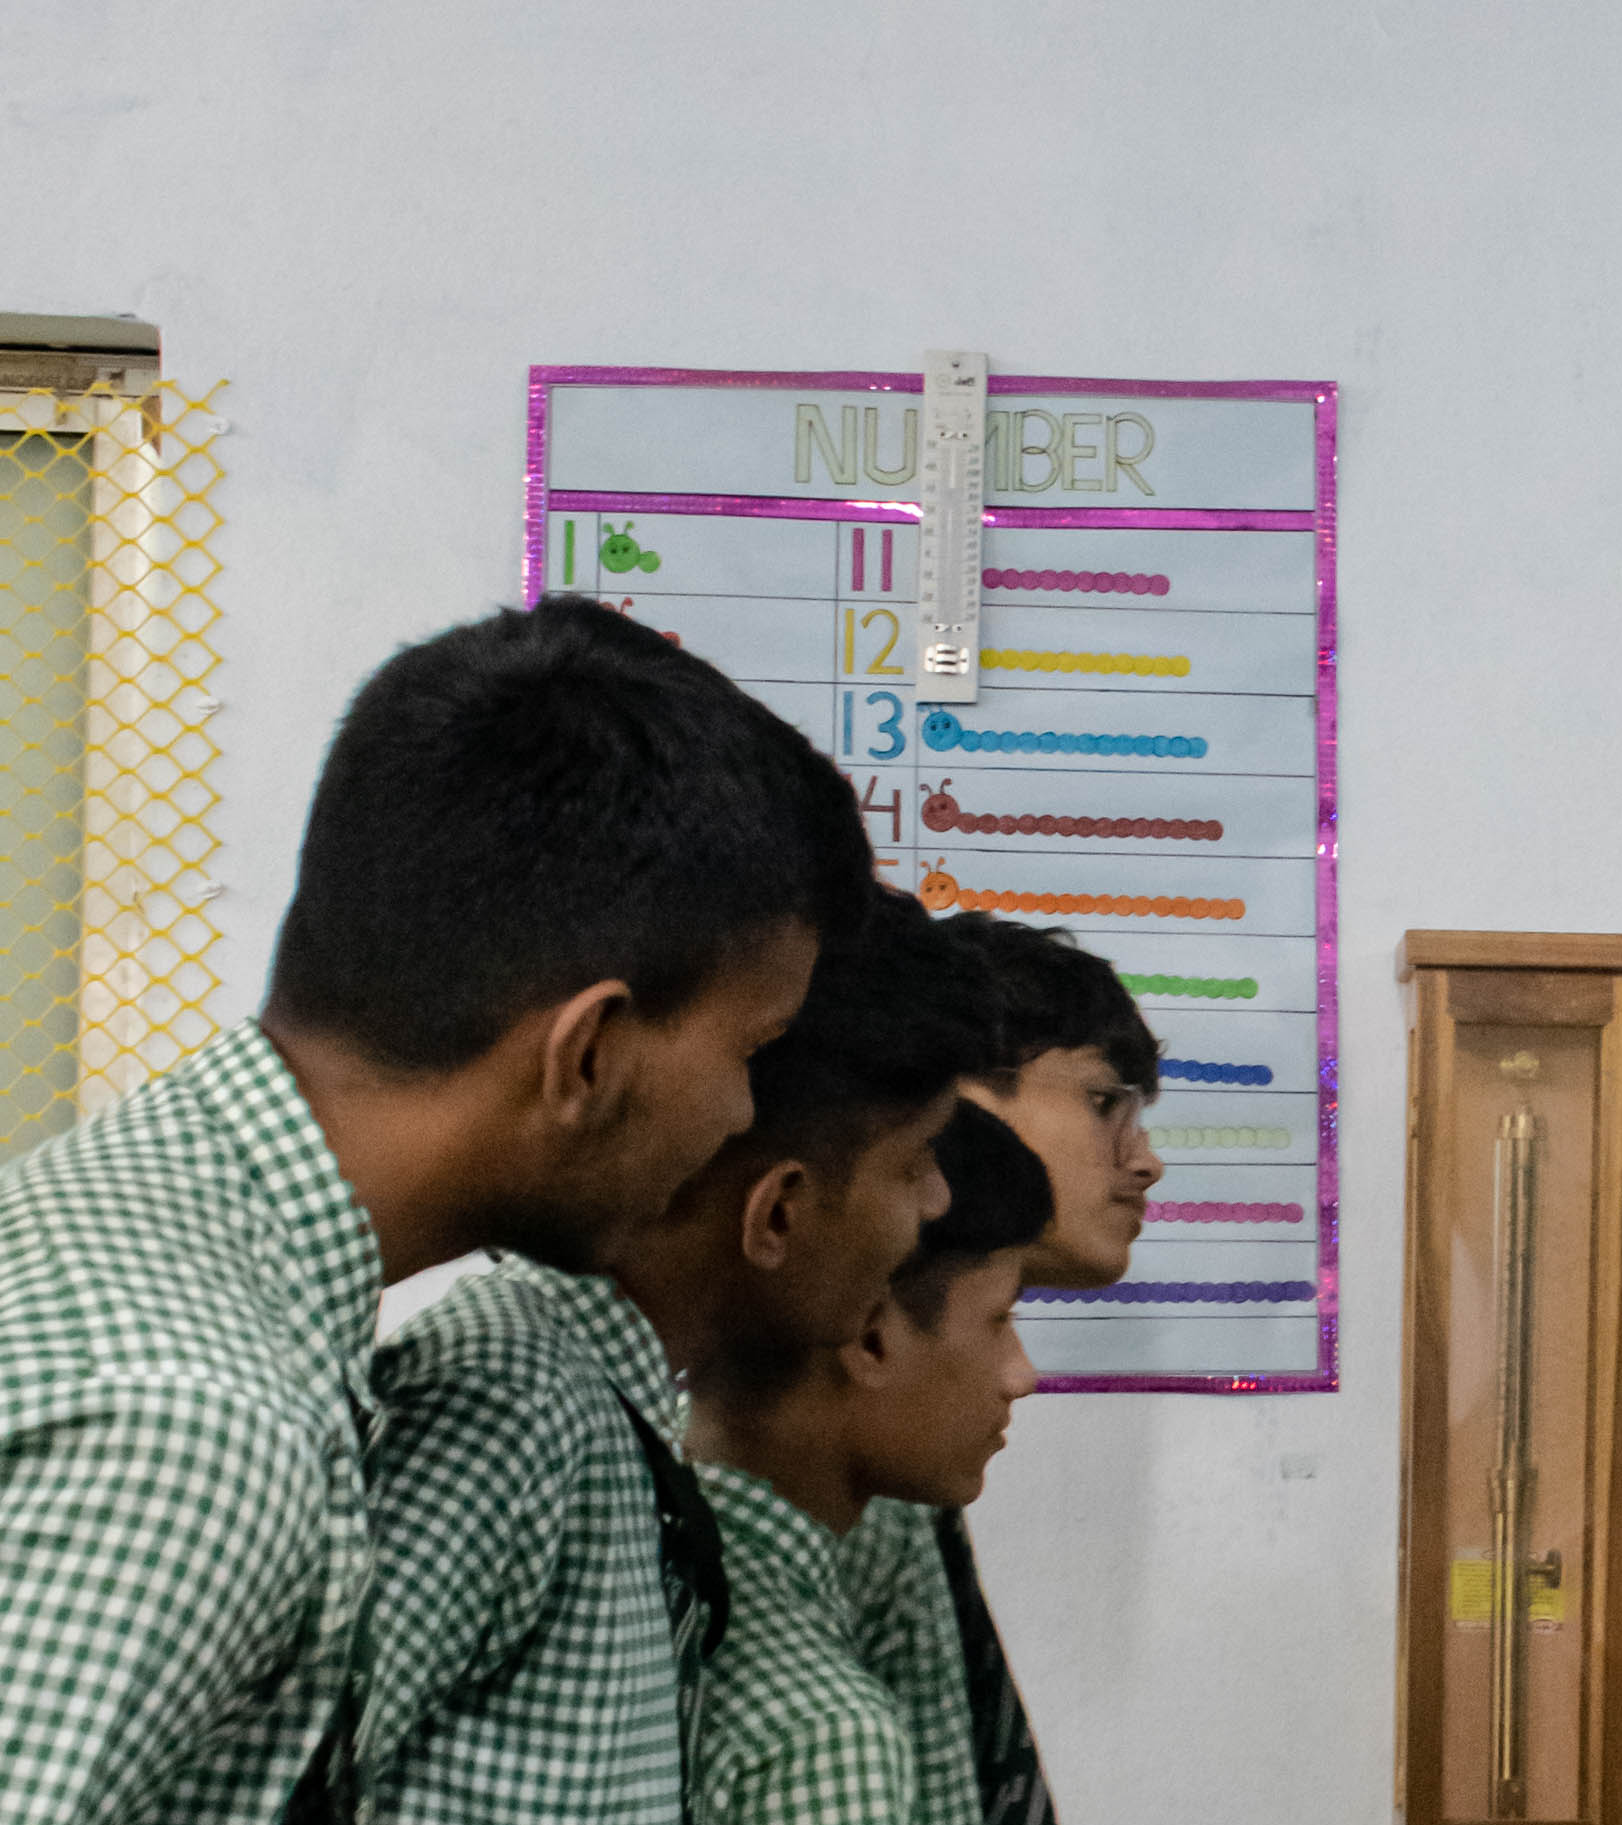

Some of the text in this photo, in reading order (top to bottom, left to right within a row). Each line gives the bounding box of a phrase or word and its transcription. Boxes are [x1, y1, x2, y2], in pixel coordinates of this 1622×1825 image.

[851, 527, 893, 592] 11
[843, 608, 905, 675] 12
[842, 691, 907, 761] 13
